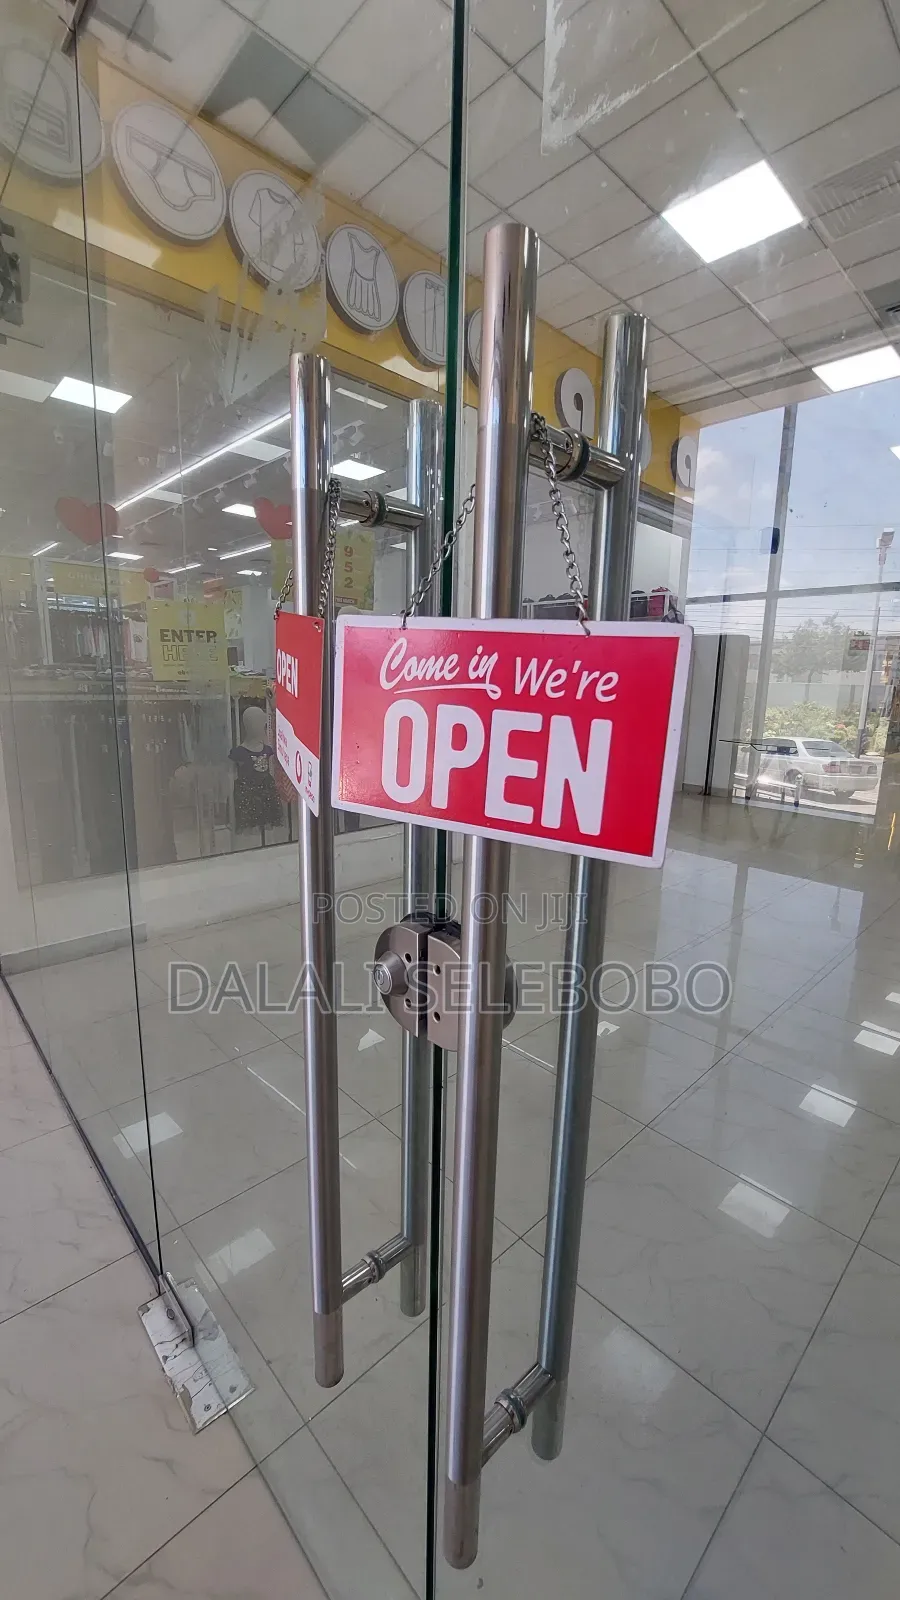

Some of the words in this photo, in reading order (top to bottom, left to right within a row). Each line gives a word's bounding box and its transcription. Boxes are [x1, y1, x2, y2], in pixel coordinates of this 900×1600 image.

[159, 628, 218, 643] ENTER
[276, 648, 299, 698] OPEN
[379, 637, 461, 690] Come
[468, 645, 502, 699] in
[514, 656, 619, 703] We're
[381, 698, 613, 836] OPEN
